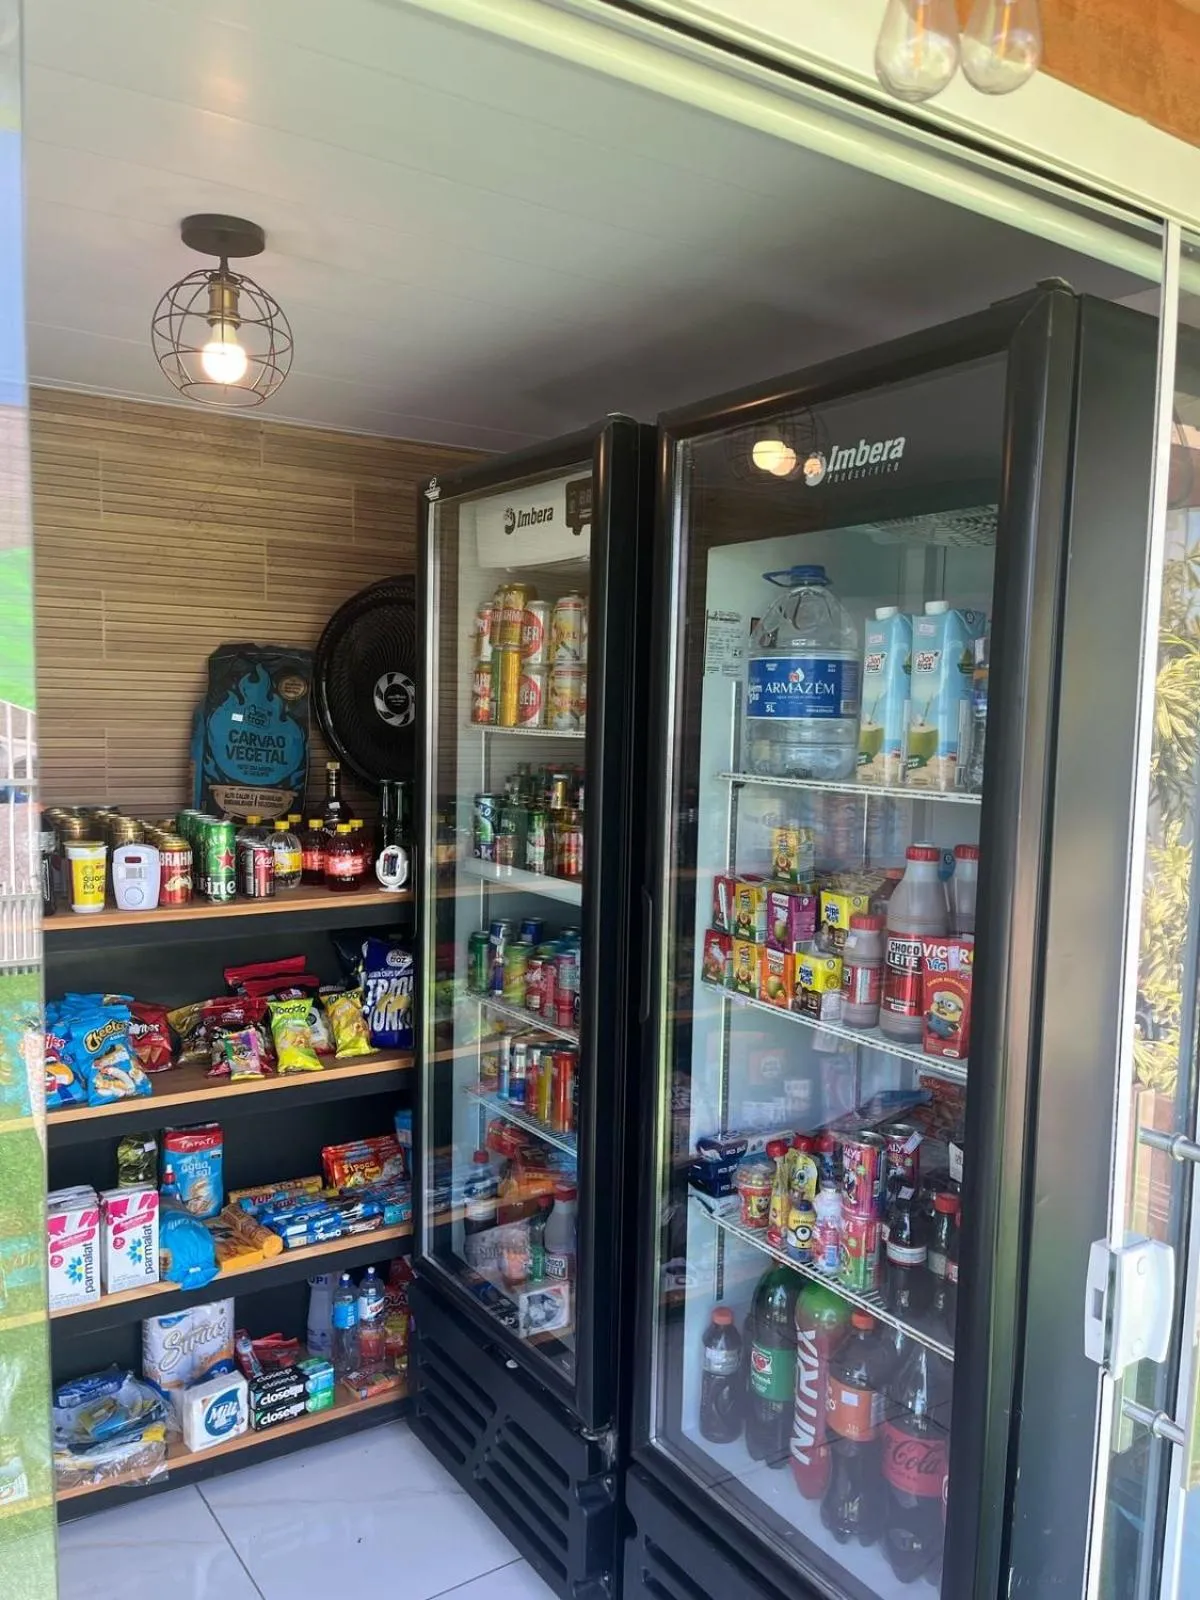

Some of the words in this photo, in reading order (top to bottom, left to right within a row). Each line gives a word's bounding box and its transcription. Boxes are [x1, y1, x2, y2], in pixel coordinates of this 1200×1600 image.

[827, 437, 906, 472] Imbera
[517, 507, 554, 528] Imbera
[765, 679, 835, 696] ARMAZÉM
[225, 744, 288, 765] VEGETAL
[889, 941, 920, 956] CHOCO
[922, 943, 969, 962] VIGR
[889, 953, 919, 967] LEITE
[144, 1224, 154, 1275] parmalat
[83, 1242, 95, 1294] parmalat
[256, 1367, 292, 1382] closeup
